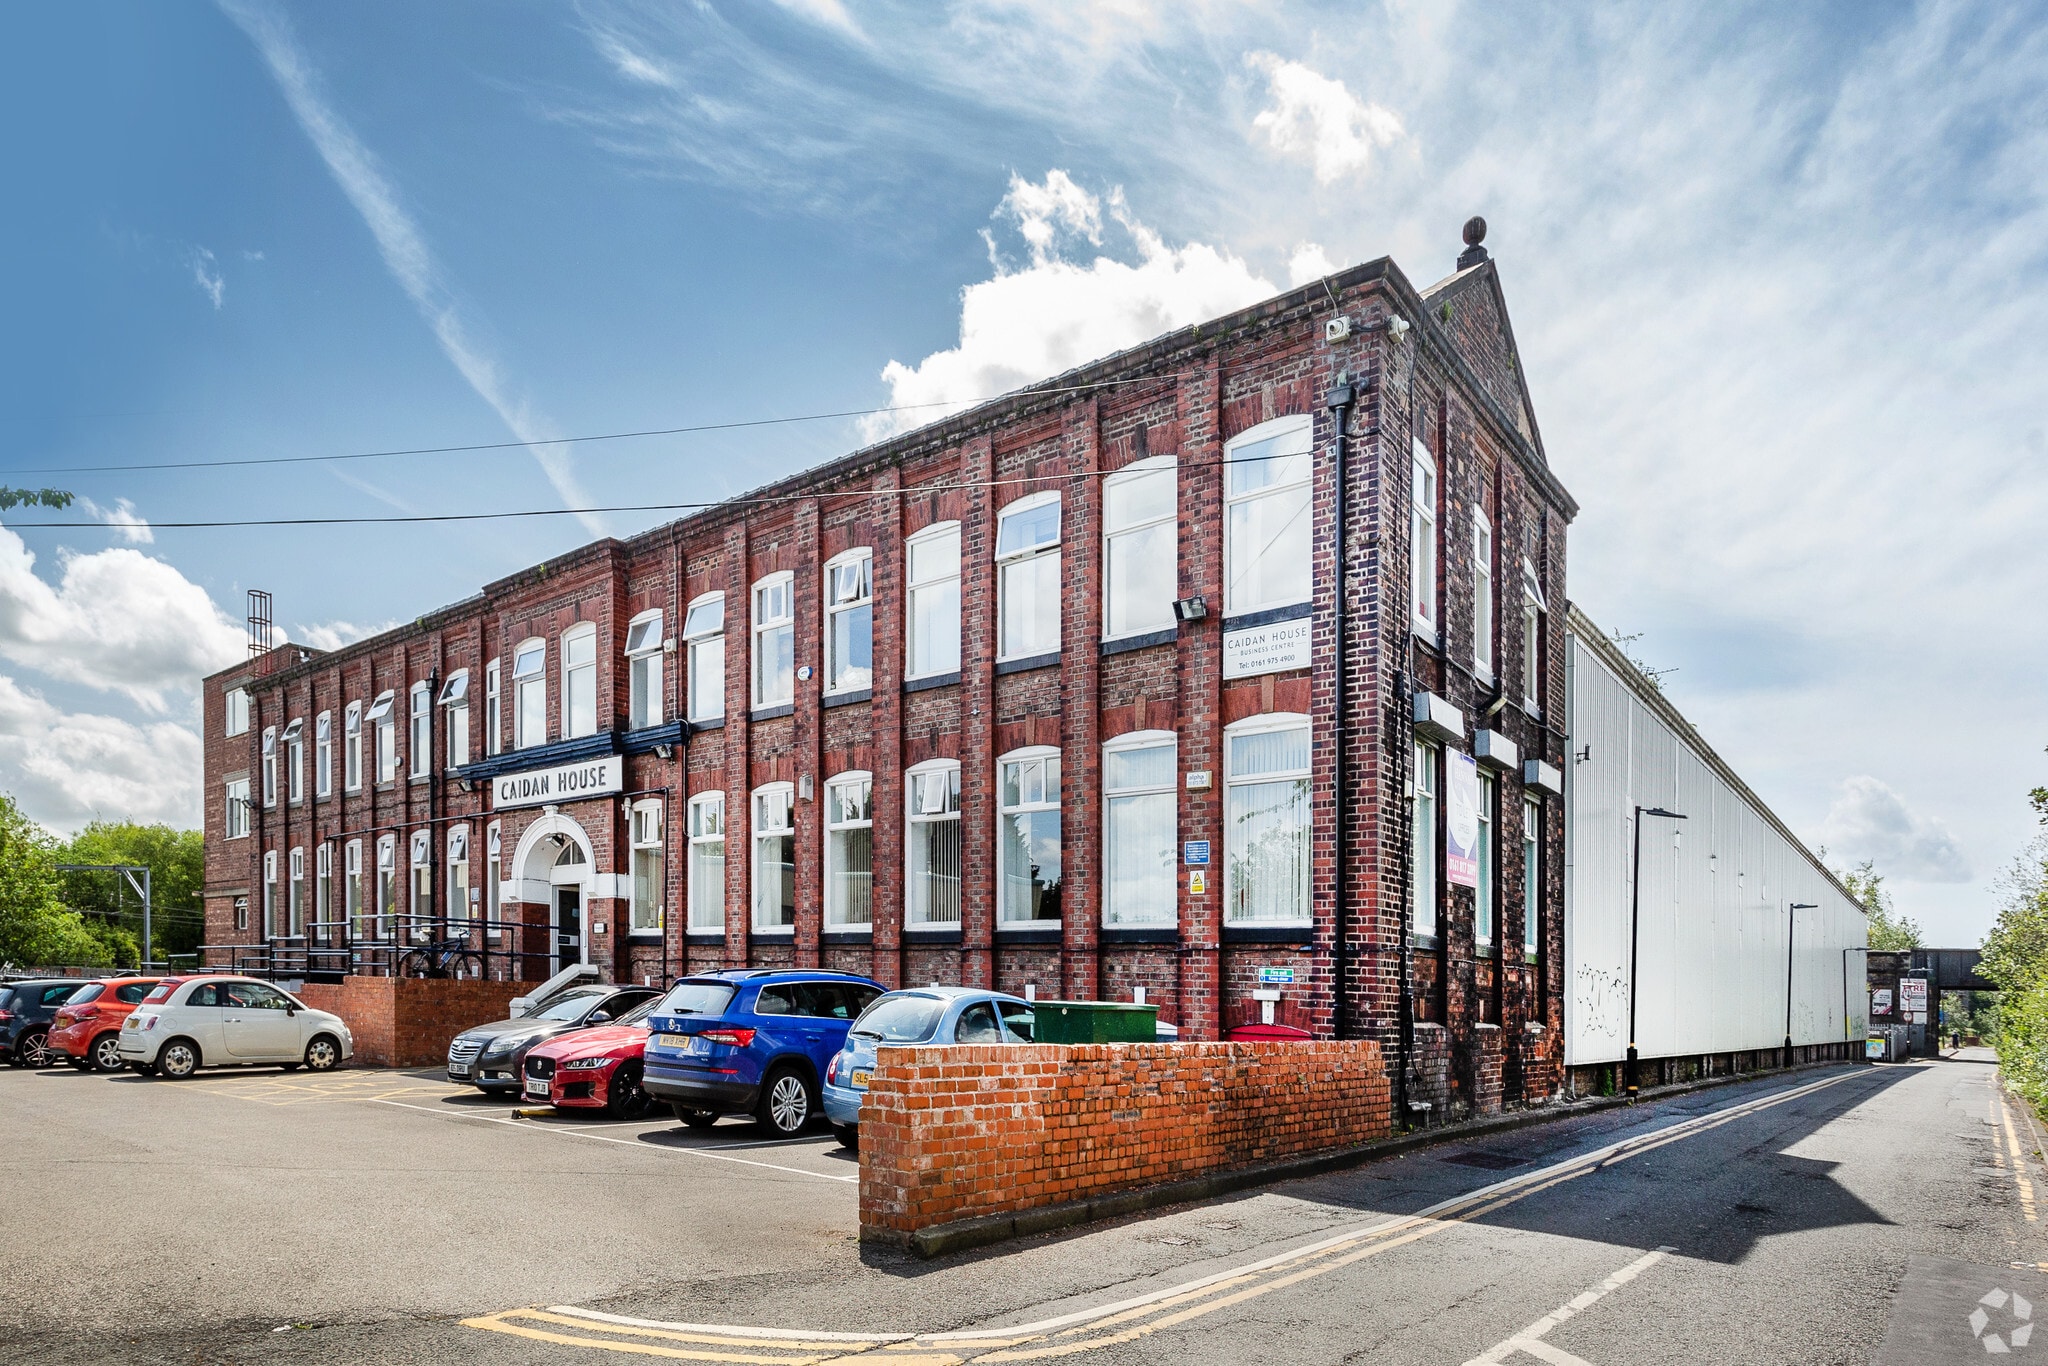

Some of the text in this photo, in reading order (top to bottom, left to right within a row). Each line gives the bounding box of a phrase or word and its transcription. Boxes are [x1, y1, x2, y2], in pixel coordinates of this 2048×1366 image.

[1228, 626, 1307, 650] CAIDAN HOUSE
[1240, 641, 1295, 656] BUSINESS CENTRE
[1239, 654, 1295, 669] Tel: 0161 975 4900
[501, 765, 607, 801] CAIDAN HOUSE
